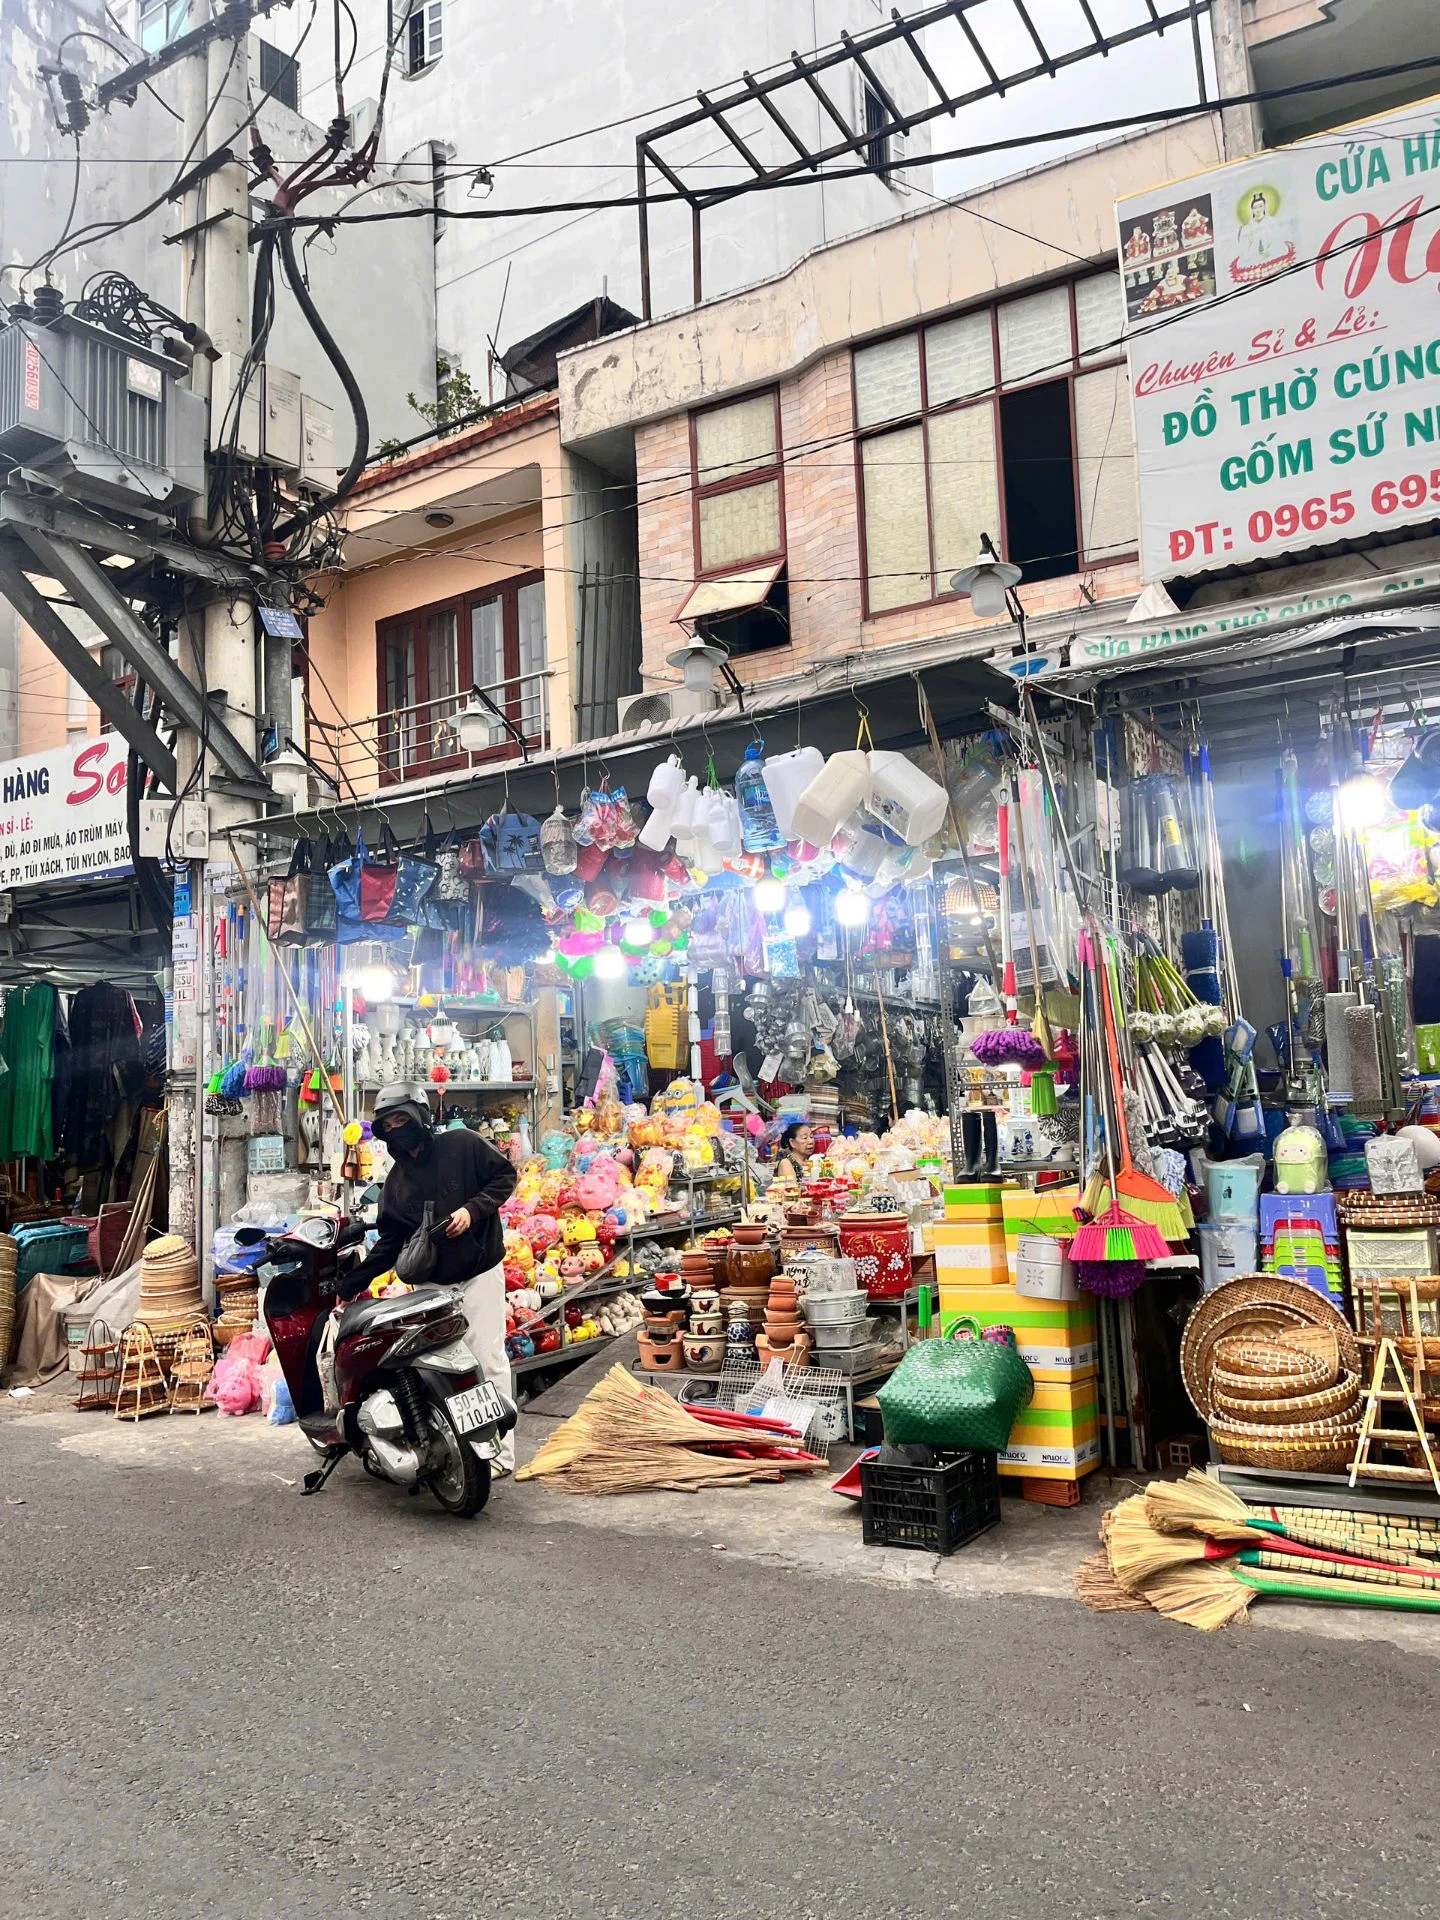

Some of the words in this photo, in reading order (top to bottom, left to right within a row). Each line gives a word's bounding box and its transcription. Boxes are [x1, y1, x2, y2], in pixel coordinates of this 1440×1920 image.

[1316, 142, 1391, 201] CỬA
[1135, 351, 1236, 397] Chuyên
[1248, 327, 1284, 361] Sỉ
[1294, 318, 1316, 347] &
[1326, 305, 1380, 339] Lẻ:
[1162, 387, 1217, 446] ĐỒ
[1231, 367, 1318, 426] THỜ
[1219, 432, 1313, 492] GỐM
[1328, 410, 1388, 464] SỨ
[1405, 405, 1440, 447] N
[1168, 521, 1233, 562] ĐT:
[1247, 489, 1355, 543] 0965
[3, 767, 49, 803] HÀNG
[20, 838, 31, 856] ÁO
[33, 838, 41, 853] ĐI
[43, 833, 63, 850] MƯA,
[65, 829, 77, 846] ÁO
[79, 824, 102, 844] TRÙM
[105, 819, 123, 838] MÁY
[25, 860, 38, 879] TÚI
[40, 857, 64, 876] XÁCH,
[66, 852, 79, 871] TÚI
[82, 849, 111, 868] NYLON,
[114, 845, 131, 862] BAO
[454, 1386, 492, 1412] 50-AA
[1042, 1454, 1063, 1462] JOTUN
